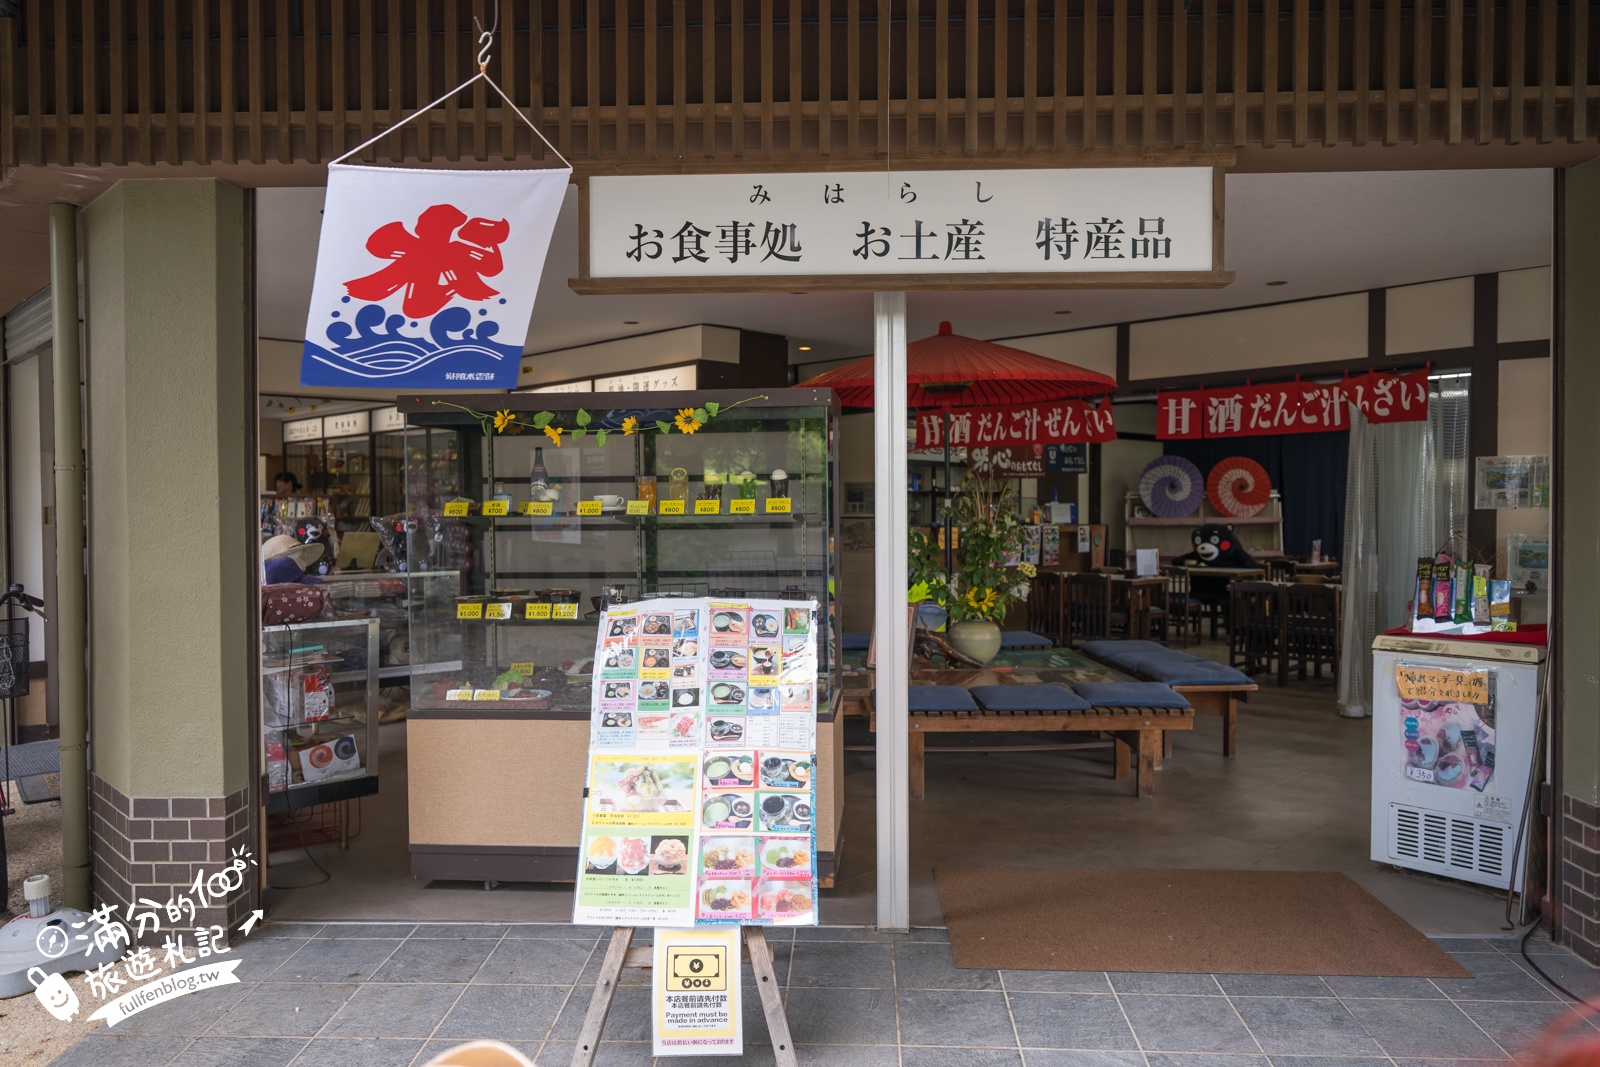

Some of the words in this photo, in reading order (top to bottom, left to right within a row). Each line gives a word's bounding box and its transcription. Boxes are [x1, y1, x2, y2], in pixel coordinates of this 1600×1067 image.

[625, 219, 803, 264] お食事処
[852, 218, 987, 263] お土産
[1034, 215, 1174, 262] 特産品
[1162, 393, 1244, 436] 甘酒
[1249, 386, 1349, 428] だんご汁
[920, 412, 973, 446] 甘酒
[977, 407, 1042, 442] だんご汁
[1409, 768, 1432, 780] ¥350
[665, 1011, 698, 1019] Payment
[661, 1038, 735, 1046] 当店は前払い制になっております
